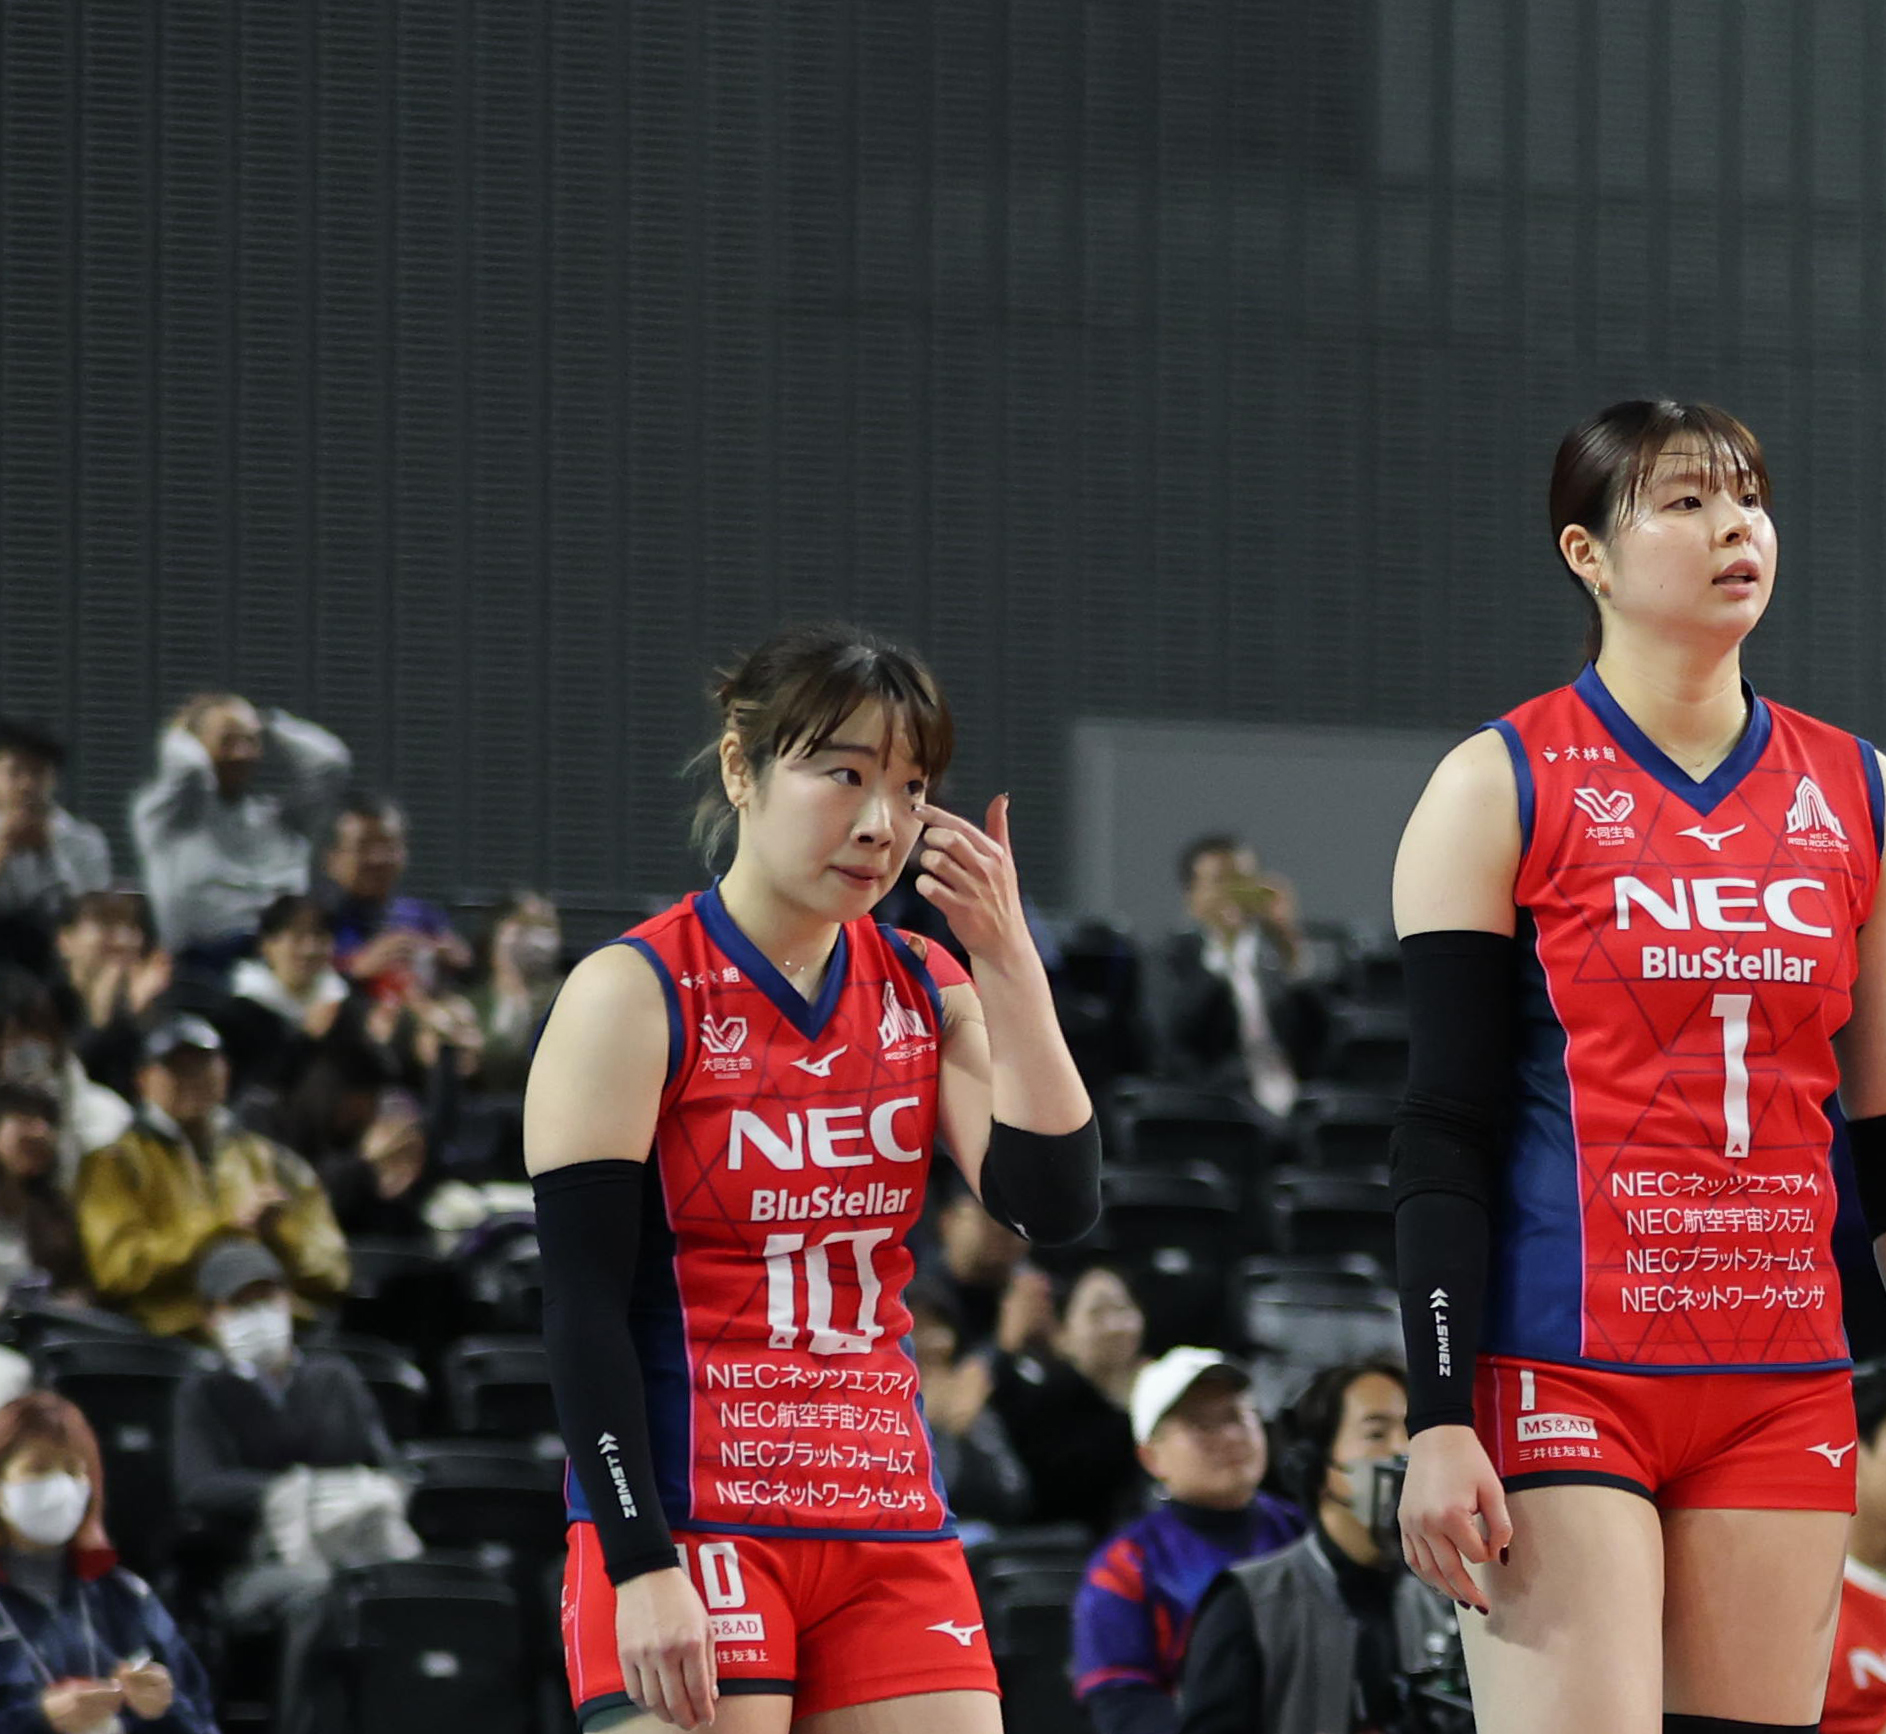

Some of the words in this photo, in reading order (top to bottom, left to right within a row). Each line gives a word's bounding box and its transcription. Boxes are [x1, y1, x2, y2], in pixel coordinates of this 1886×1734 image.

[1564, 746, 1617, 762] 大林組
[1585, 826, 1635, 839] 大同生命
[1613, 875, 1833, 938] NEC
[1642, 946, 1817, 983] BluStellar
[702, 1056, 752, 1072] 大同生命
[1710, 993, 1753, 1158] 1
[727, 1096, 923, 1170] NEC
[1612, 1171, 1818, 1198] NECネッツエスアイ
[751, 1182, 912, 1221] BluStellar
[1626, 1208, 1814, 1235] NEC航空宇宙システム
[1626, 1246, 1816, 1274] NECプラットフォームズ
[763, 1227, 893, 1356] 10
[1621, 1284, 1826, 1313] NECネットワーク・センサ
[706, 1364, 914, 1400] NECネッツエスアイ
[720, 1402, 911, 1437] NEC航空宇宙システム
[1523, 1419, 1592, 1435] MS&AD
[720, 1441, 916, 1475] NECプラットフォームズ
[1519, 1446, 1603, 1462] 三井住友海上
